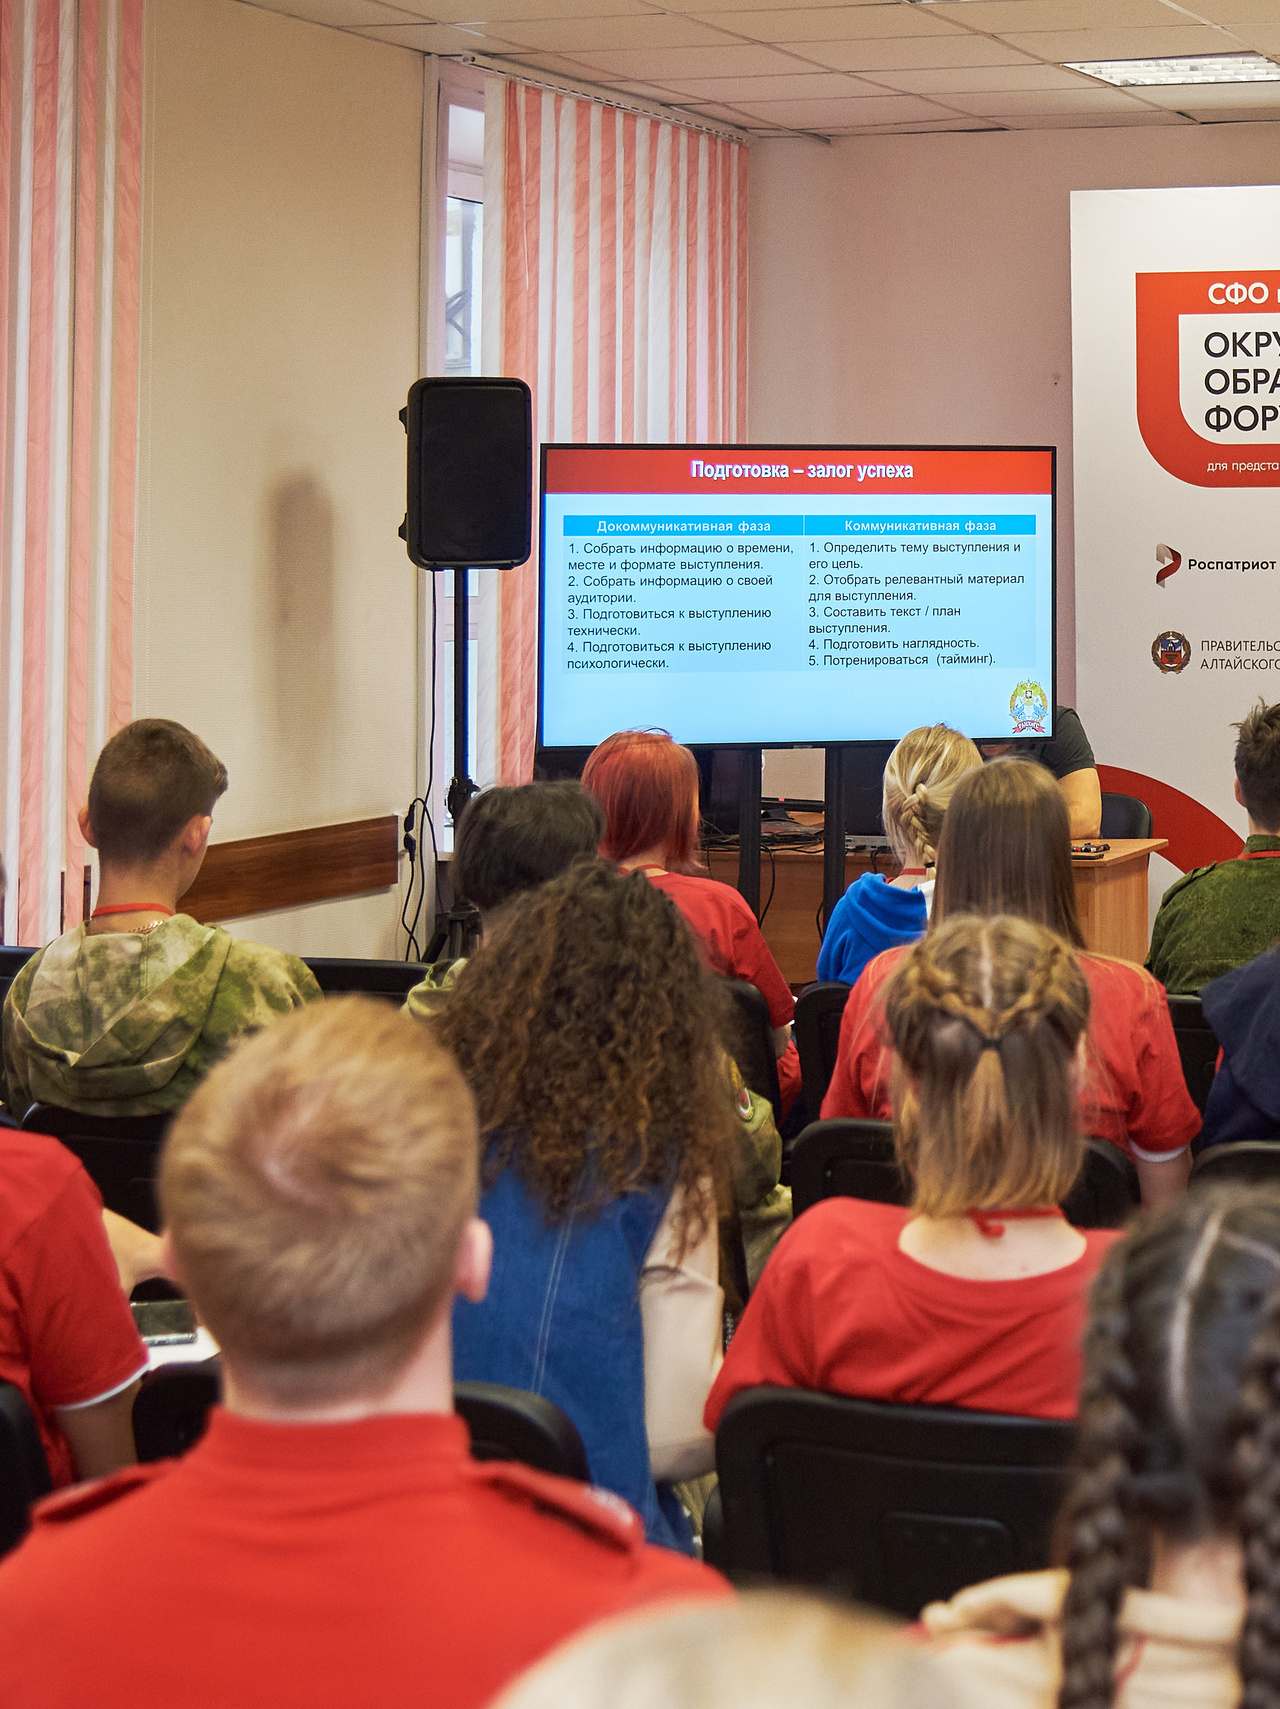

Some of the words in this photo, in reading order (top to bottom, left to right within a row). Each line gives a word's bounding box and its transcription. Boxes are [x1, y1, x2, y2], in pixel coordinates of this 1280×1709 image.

[1208, 282, 1268, 304] СФО
[691, 460, 790, 481] Подготовка
[807, 464, 855, 479] залог
[856, 464, 914, 483] успеха
[1206, 462, 1228, 473] для
[597, 520, 733, 534] Докоммуникативная
[737, 520, 771, 534] фаза
[845, 520, 960, 534] Коммуникативная
[964, 520, 997, 534] фаза
[569, 543, 579, 554] 1.
[583, 542, 637, 556] Собрать
[640, 542, 723, 556] информацию
[726, 544, 734, 554] о
[737, 544, 794, 556] времени,
[809, 542, 820, 553] 1.
[823, 541, 897, 556] Определить
[900, 544, 929, 555] тему
[932, 543, 1010, 555] выступления
[1013, 543, 1021, 552] и
[568, 561, 605, 571] месте
[609, 561, 617, 570] и
[620, 559, 676, 573] формате
[680, 560, 764, 573] выступления.
[808, 560, 829, 569] его
[831, 560, 863, 571] цель.
[1188, 558, 1277, 573] Роспатриот
[567, 575, 579, 587] 2.
[583, 575, 636, 589] Собрать
[640, 575, 723, 589] информацию
[726, 577, 734, 586] о
[737, 574, 773, 586] своей
[808, 574, 820, 585] 2.
[823, 573, 881, 588] Отобрать
[884, 573, 964, 587] релевантный
[967, 575, 1025, 587] материал
[567, 594, 636, 606] аудитории.
[808, 592, 831, 603] для
[835, 592, 916, 604] выступления.
[567, 608, 579, 620] 3.
[583, 608, 675, 621] Подготовиться
[679, 610, 685, 619] к
[688, 609, 772, 621] выступлению
[808, 606, 819, 618] 3.
[823, 606, 887, 618] Составить
[889, 608, 922, 617] текст
[924, 605, 930, 616] /
[932, 607, 961, 617] план
[567, 627, 641, 637] технически.
[808, 624, 891, 636] выступления.
[566, 641, 578, 653] 4.
[582, 641, 675, 654] Подготовиться
[678, 643, 685, 652] к
[688, 641, 772, 654] выступлению
[808, 638, 819, 650] 4.
[823, 638, 899, 651] Подготовить
[902, 639, 980, 650] наглядность.
[567, 659, 669, 669] психологически.
[808, 654, 819, 666] 5.
[823, 654, 929, 668] Потренироваться
[936, 652, 996, 667] (тайминг).
